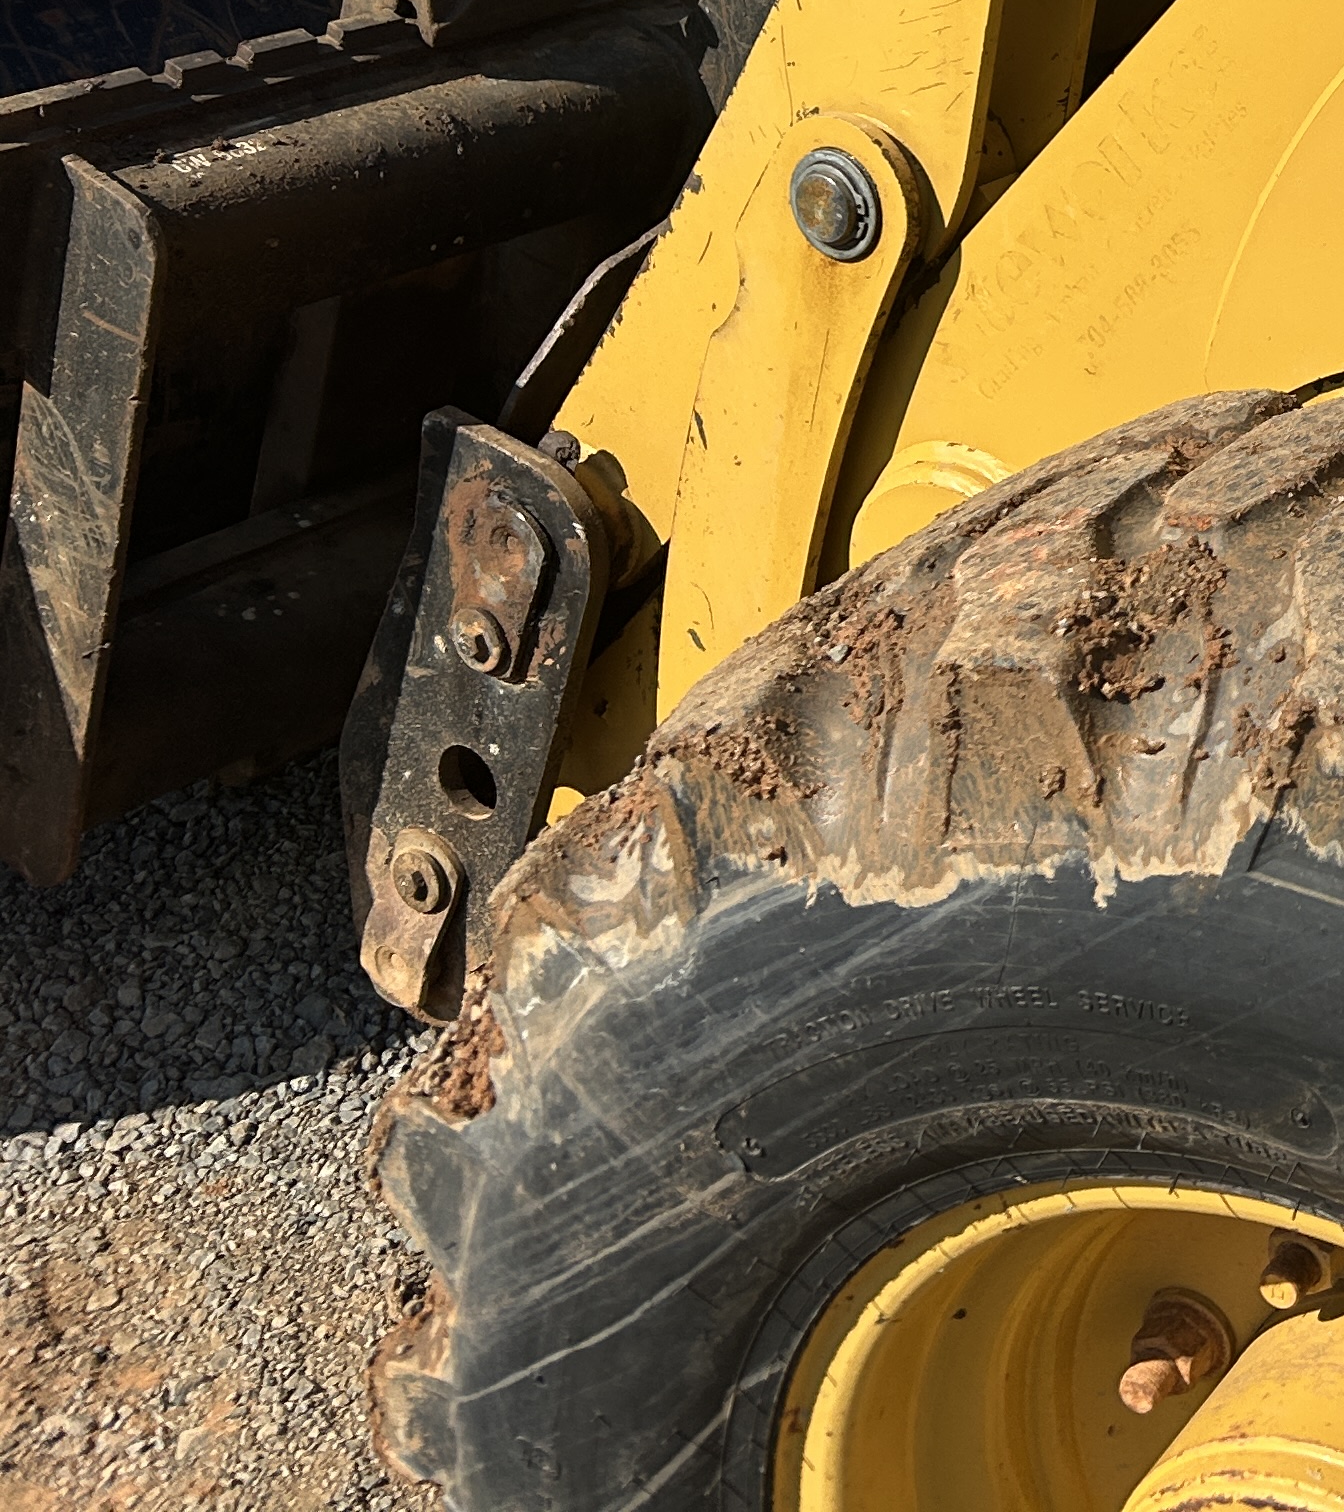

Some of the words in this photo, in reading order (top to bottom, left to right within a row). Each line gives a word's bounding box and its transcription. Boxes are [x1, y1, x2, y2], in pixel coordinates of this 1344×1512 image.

[883, 989, 956, 1021] DRIVE
[972, 985, 1059, 1011] WHEEL
[1077, 989, 1191, 1028] SERVICE
